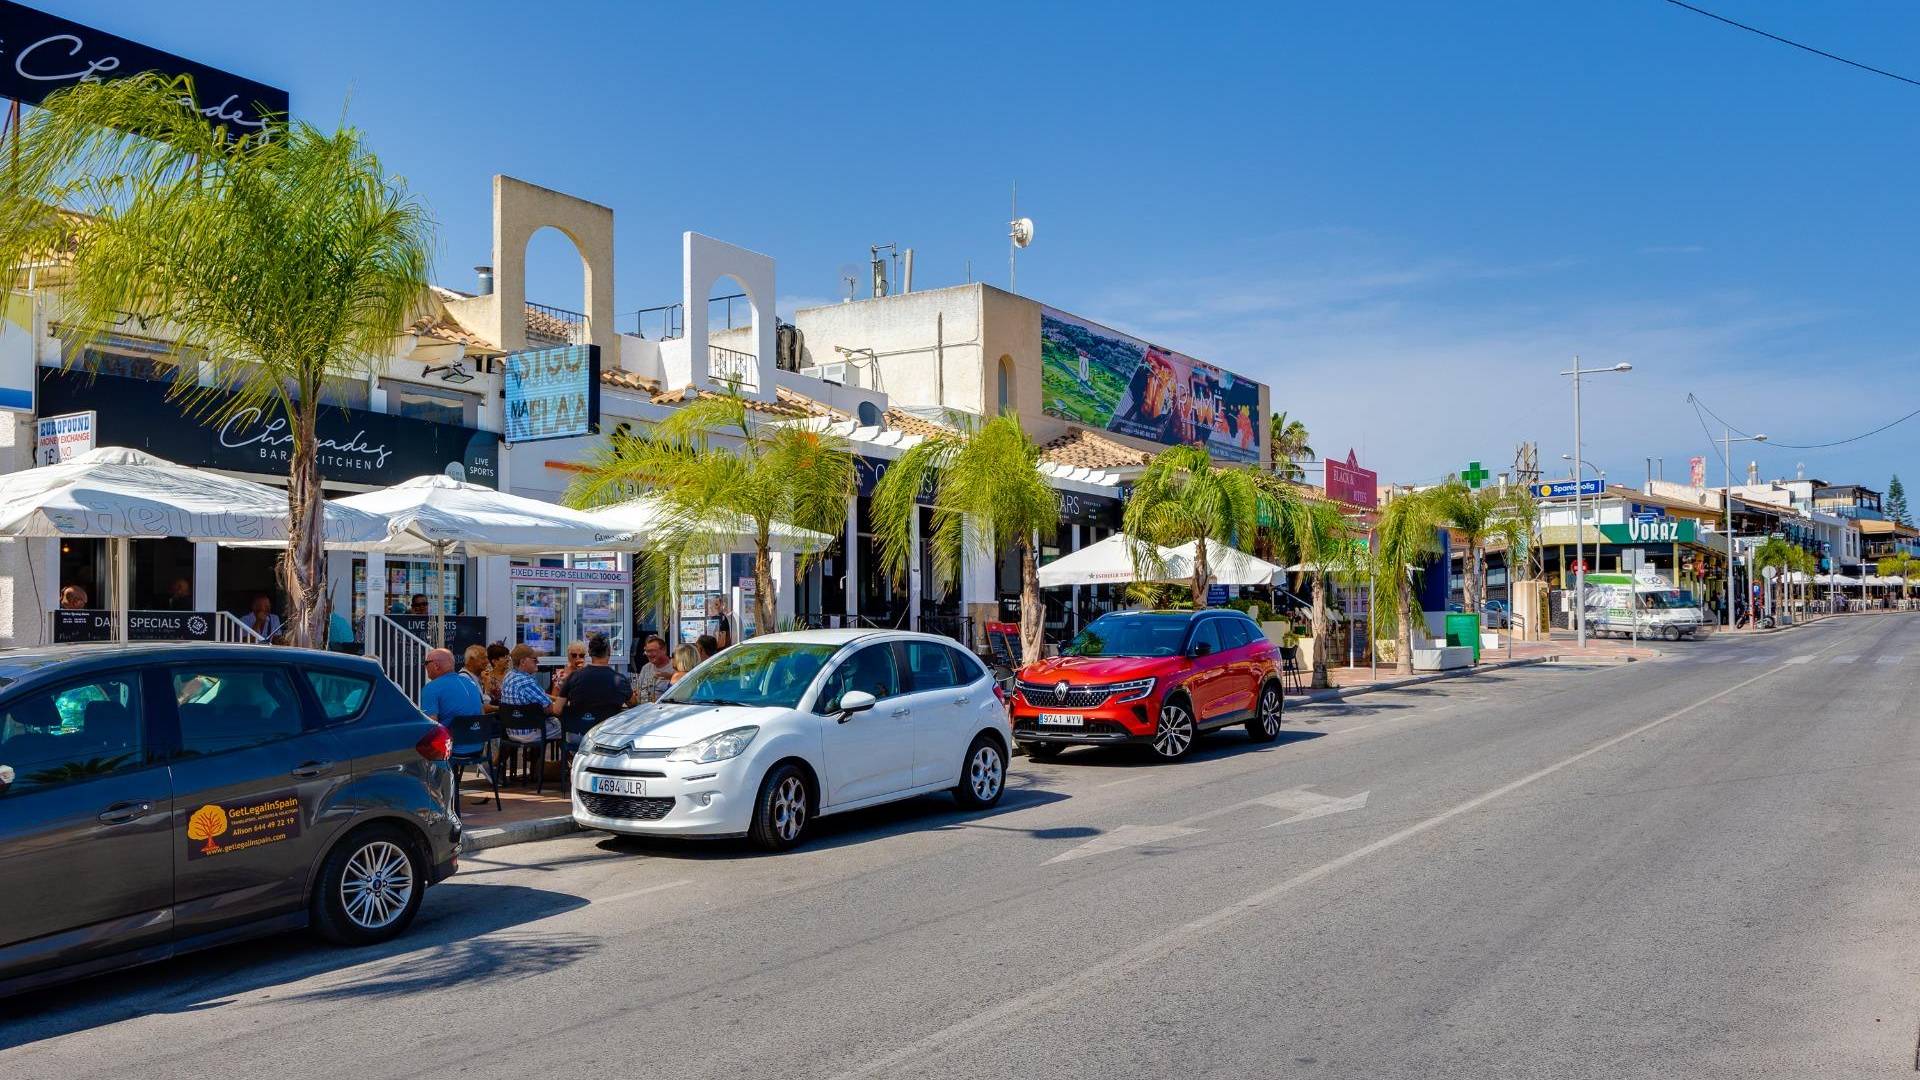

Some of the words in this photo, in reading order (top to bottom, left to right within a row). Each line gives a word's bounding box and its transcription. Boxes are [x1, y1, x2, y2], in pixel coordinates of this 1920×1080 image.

[40, 415, 90, 437] EUROPOUND
[40, 435, 60, 447] MONEY
[60, 432, 90, 444] EXCHANGE
[220, 407, 393, 469] Chaades
[260, 448, 287, 461] BAR
[313, 454, 373, 471] KITCHEN
[474, 456, 489, 468] LIVE
[469, 465, 494, 478] SPORTS
[1553, 482, 1595, 494] Spaniaolig
[1628, 517, 1679, 541] VORAZ
[511, 568, 534, 578] FIXED
[535, 569, 549, 578] FEE
[551, 570, 566, 579] FOR
[599, 573, 622, 581] 1000€
[130, 617, 181, 629] SPECIALS
[408, 620, 426, 630] LIVE
[427, 621, 457, 630] SPRTS
[598, 780, 620, 793] 4694
[624, 781, 642, 795] JLR
[277, 818, 285, 828] 22
[287, 817, 295, 827] 19
